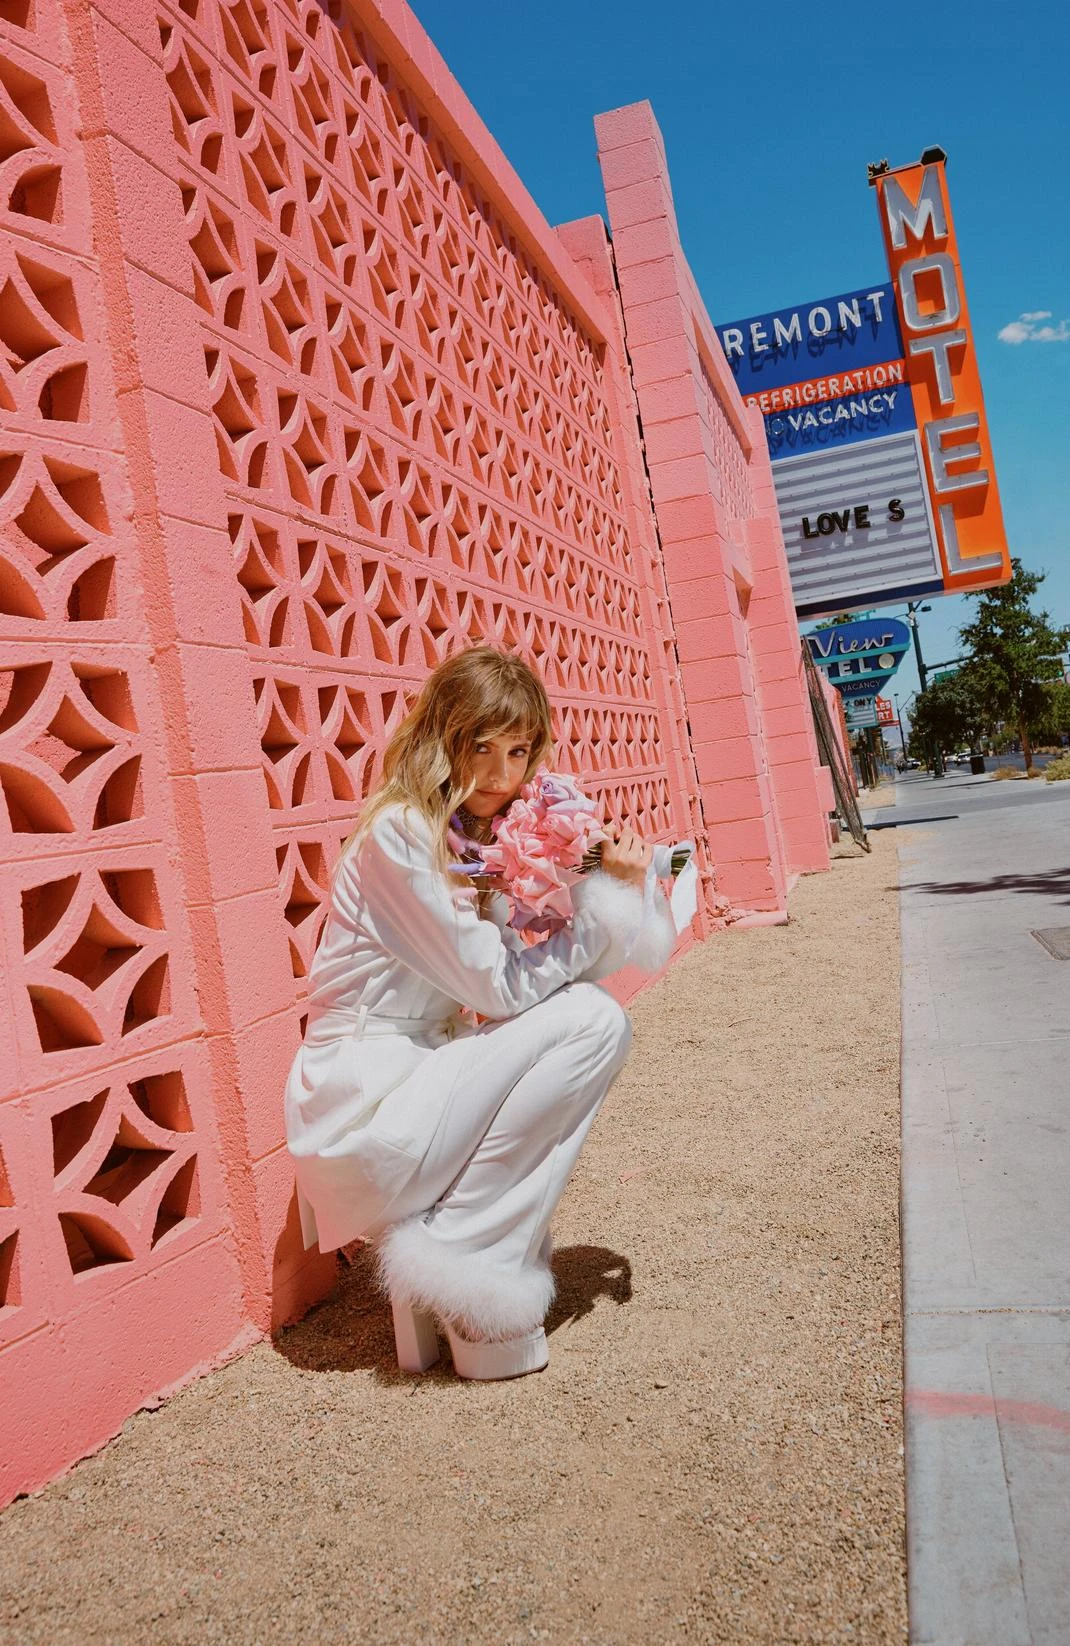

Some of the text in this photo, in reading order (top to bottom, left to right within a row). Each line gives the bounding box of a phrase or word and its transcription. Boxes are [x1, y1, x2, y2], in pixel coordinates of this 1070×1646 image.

[722, 291, 885, 359] REMONT
[882, 164, 1003, 576] MOTEL
[788, 391, 898, 432] VACANCY
[801, 498, 905, 540] LOVE S
[806, 631, 894, 657] View
[841, 679, 880, 692] VACANCY
